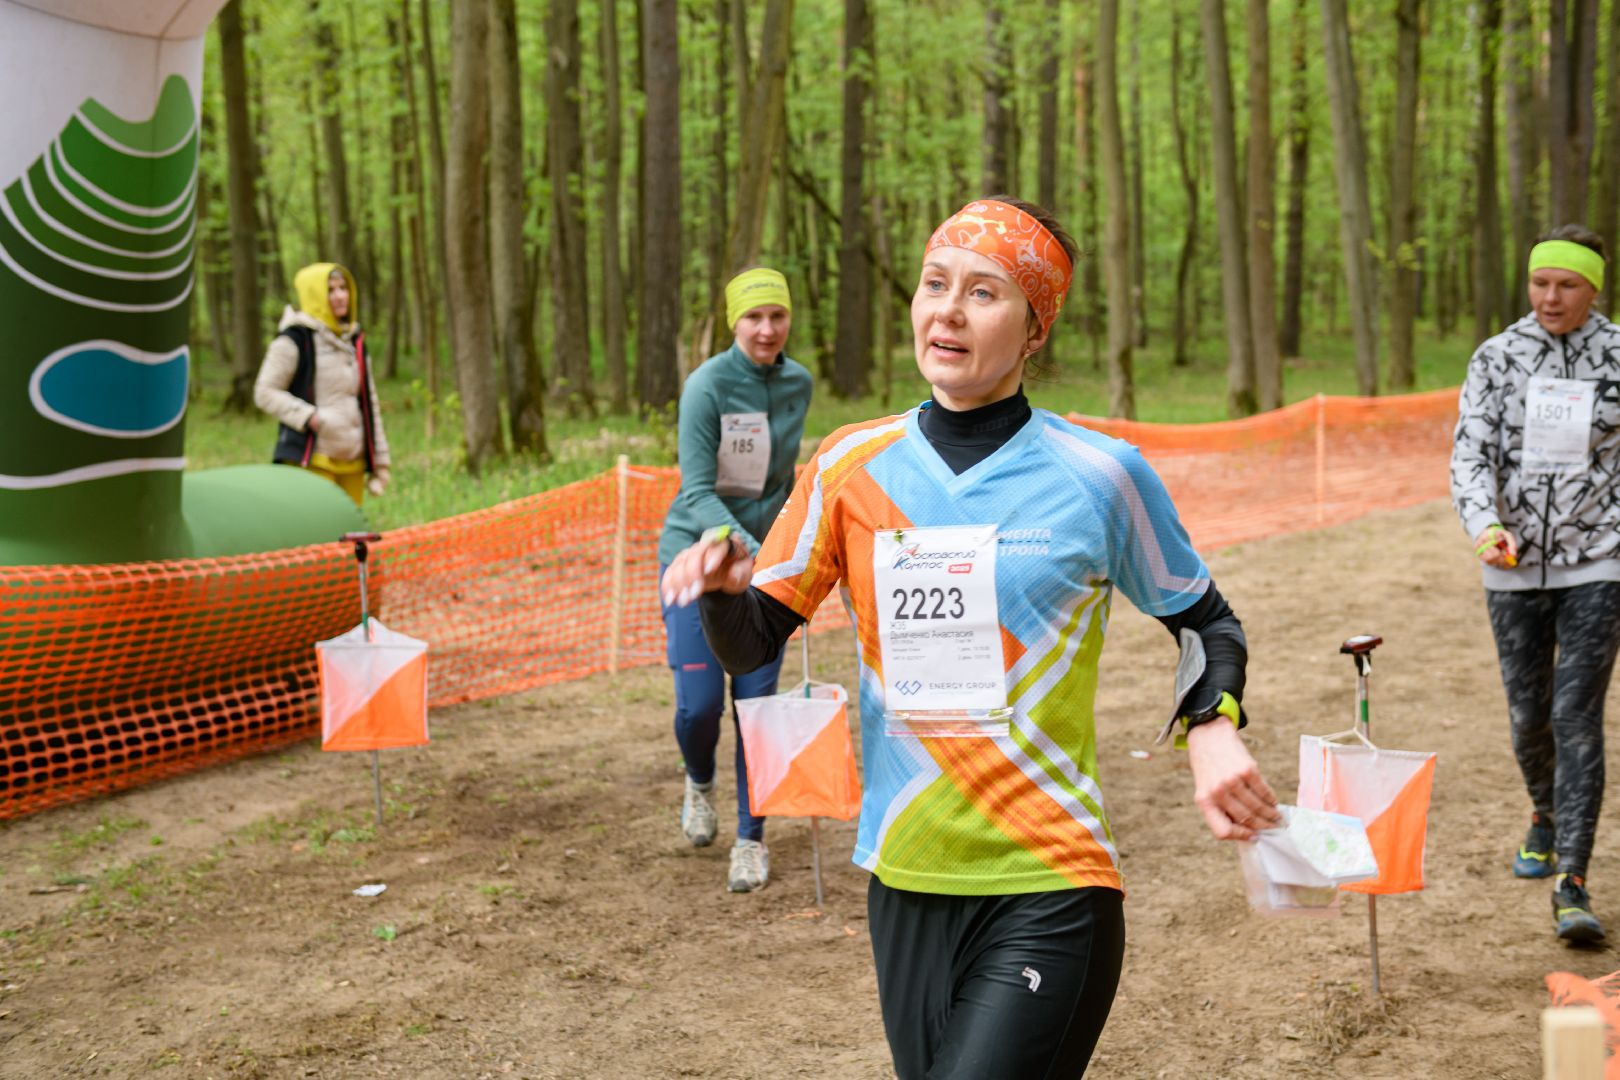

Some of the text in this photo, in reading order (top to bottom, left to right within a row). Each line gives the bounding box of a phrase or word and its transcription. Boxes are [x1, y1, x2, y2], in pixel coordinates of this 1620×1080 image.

[1536, 404, 1572, 420] 1501
[732, 438, 755, 454] 185
[1000, 545, 1050, 557] ТРОПА
[892, 587, 965, 620] 2223
[928, 681, 997, 690] ENERGY GROUP
